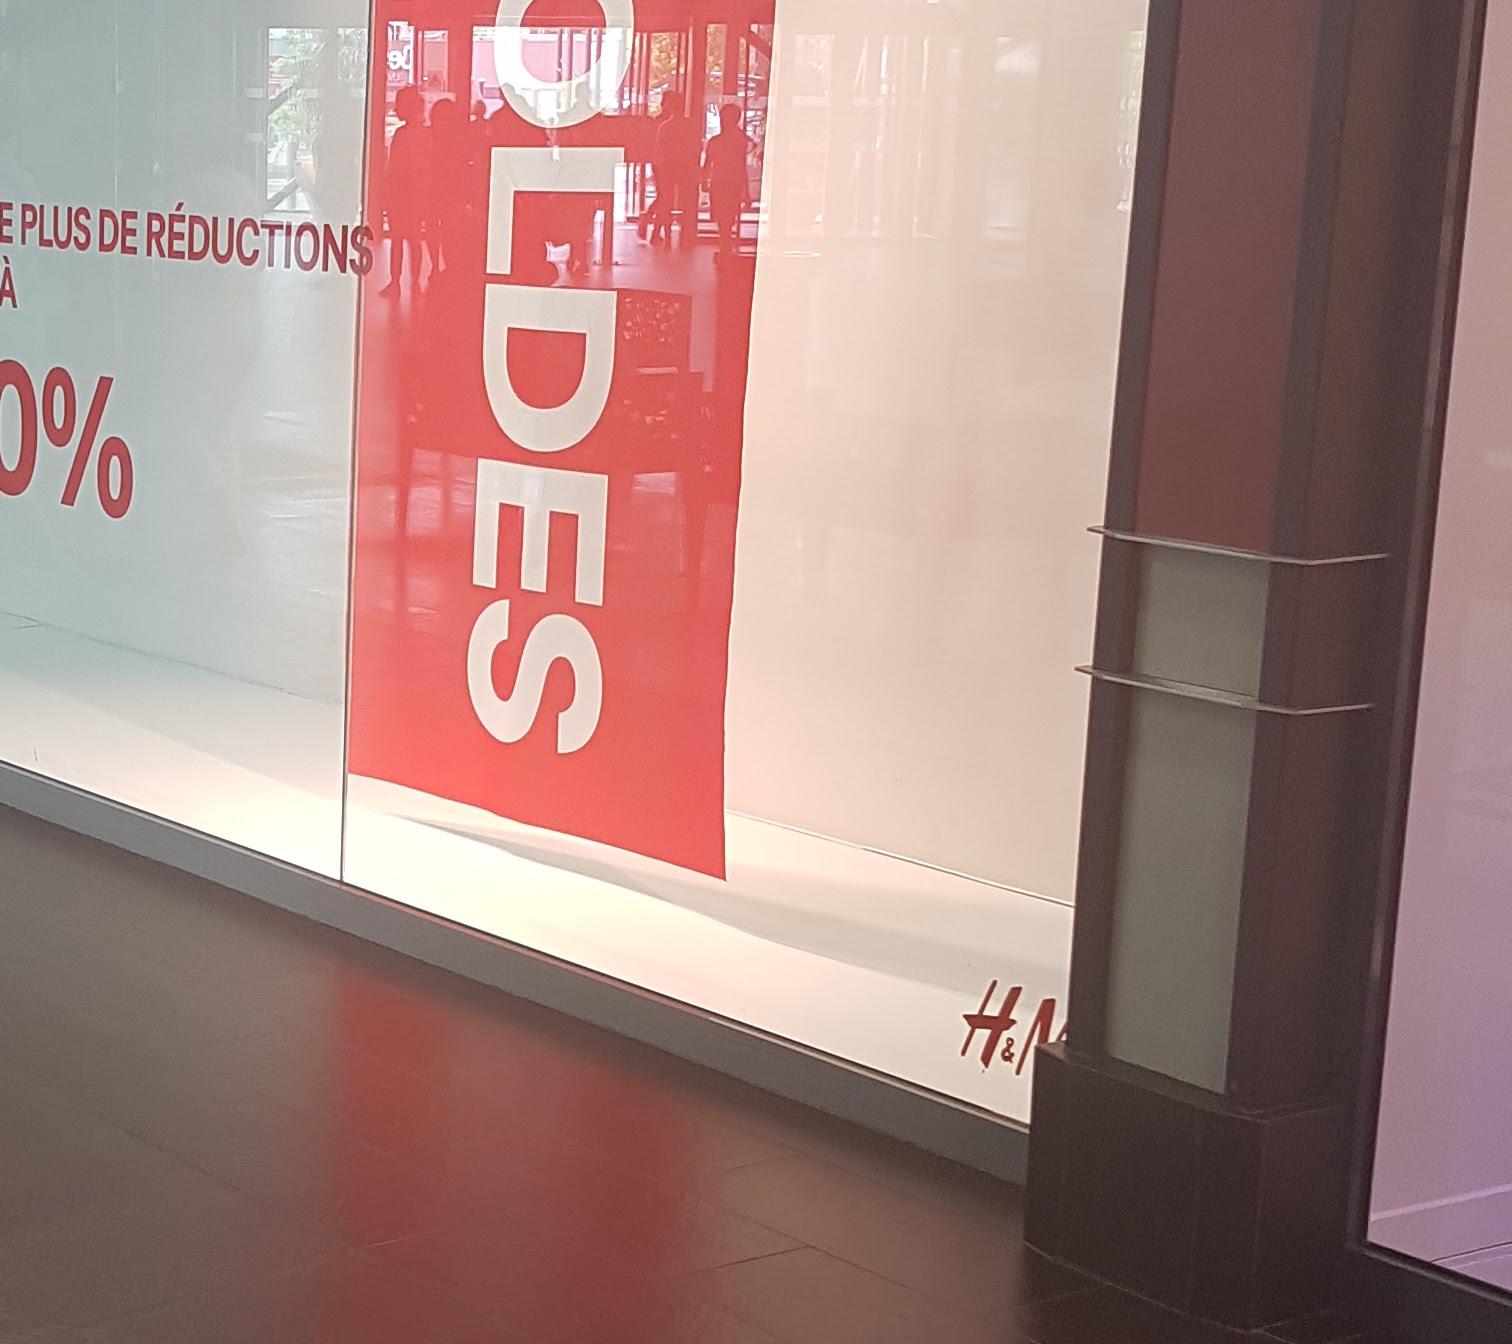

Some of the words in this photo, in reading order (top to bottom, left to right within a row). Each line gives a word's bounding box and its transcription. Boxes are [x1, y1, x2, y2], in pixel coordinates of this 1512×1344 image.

[20, 203, 92, 252] PLUS
[98, 208, 138, 256] DE
[146, 202, 374, 276] RÉDUCTIONS
